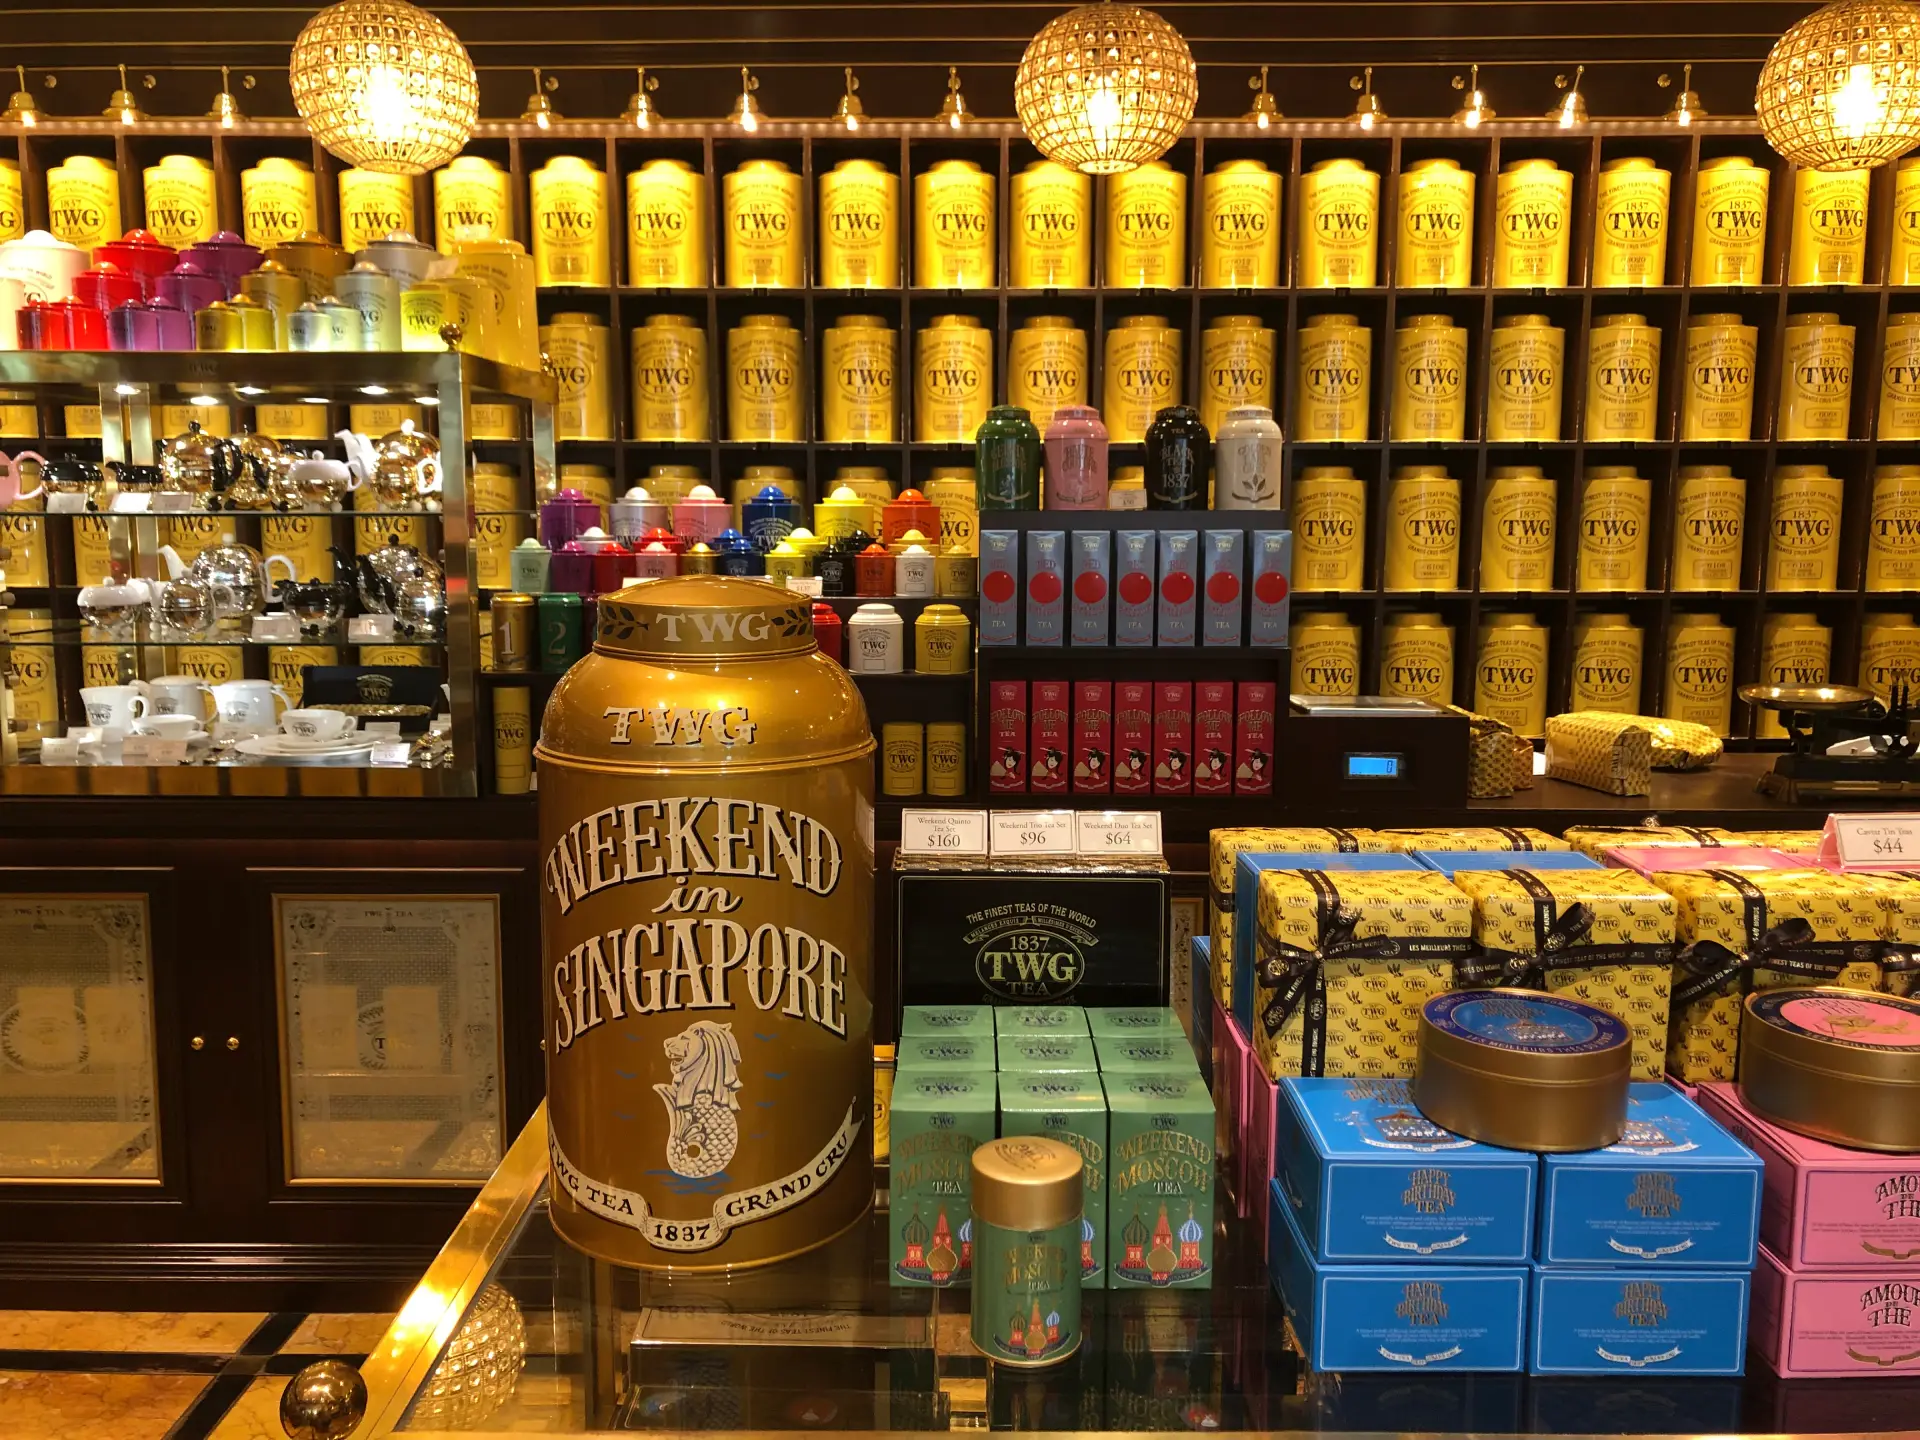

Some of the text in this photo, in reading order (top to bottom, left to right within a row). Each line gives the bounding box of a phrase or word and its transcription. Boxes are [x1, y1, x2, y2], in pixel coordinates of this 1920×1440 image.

[60, 199, 82, 210] 1837
[1134, 203, 1157, 213] 1837
[1522, 202, 1547, 213] 1837
[1729, 200, 1752, 210] 1837
[52, 211, 99, 227] TWG
[150, 210, 197, 227] TWG
[350, 211, 401, 229] TWG
[542, 212, 592, 229] TWG
[737, 213, 786, 231] TWG
[937, 213, 986, 231] TWG
[1120, 213, 1170, 231] TWG
[1319, 213, 1368, 231] TWG
[1506, 213, 1559, 230] TWG
[1608, 211, 1660, 230] TWG
[1711, 211, 1761, 229] TWG
[62, 227, 84, 236] TEA
[1133, 231, 1157, 240] TEA
[1520, 230, 1546, 239] TEA
[1726, 229, 1750, 237] TEA
[1325, 359, 1346, 368] 1837
[1716, 357, 1739, 366] 1837
[640, 367, 689, 385] TWG
[928, 370, 977, 387] TWG
[1121, 369, 1171, 388] TWG
[1309, 368, 1359, 386] TWG
[1500, 368, 1552, 386] TWG
[1698, 367, 1749, 385] TWG
[1801, 367, 1849, 384] TWG
[1322, 385, 1347, 395] TEA
[1713, 384, 1737, 393] TEA
[1162, 473, 1190, 488] 1837
[1318, 510, 1341, 519] 1837
[1793, 510, 1817, 519] 1837
[1303, 519, 1353, 537] TWG
[1409, 519, 1456, 536] TWG
[1503, 519, 1551, 537] TWG
[1775, 519, 1830, 536] TWG
[1316, 536, 1341, 545] TEA
[1790, 536, 1815, 545] TEA
[655, 611, 771, 643] TWG
[1215, 621, 1230, 629] TEA
[499, 621, 515, 655] 1
[548, 621, 567, 655] 2
[861, 641, 886, 650] TWG
[928, 641, 952, 650] TWG
[1405, 658, 1428, 667] 1837
[1497, 658, 1521, 667] 1837
[180, 663, 230, 681] TWG
[1305, 667, 1353, 684] TWG
[1390, 666, 1440, 684] TWG
[1483, 666, 1534, 684] TWG
[1679, 666, 1728, 684] TWG
[363, 687, 387, 697] TWG
[1402, 684, 1428, 693] TEA
[1494, 684, 1520, 693] TEA
[990, 708, 1026, 723] FOLLOW
[1032, 708, 1068, 723] FOLLOW
[1075, 708, 1111, 723] FOLLOW
[1196, 709, 1232, 724] FOLLOW
[1237, 709, 1273, 725] FOLLOW
[496, 728, 524, 739] TWG
[603, 706, 757, 745] TWG
[889, 754, 916, 763] TWG
[932, 754, 958, 763] TWG
[917, 817, 971, 825] Weekend Quinto
[1029, 821, 1043, 829] Trio
[1044, 821, 1055, 829] Tea
[1056, 821, 1066, 829] Set
[1142, 821, 1153, 829] Set
[1019, 831, 1046, 846] $96
[1105, 831, 1131, 845] $64
[1882, 827, 1896, 836] Tin
[928, 834, 961, 848] $160
[1873, 837, 1903, 854] $44
[546, 796, 843, 915] WEEKEND
[651, 876, 743, 914] in
[966, 911, 984, 925] THE
[984, 904, 1013, 919] FINEST
[1014, 903, 1036, 913] TEAS
[1037, 903, 1049, 913] OF
[1050, 905, 1068, 917] THE
[1068, 909, 1097, 929] WORLD
[1636, 919, 1658, 928] TWG
[1284, 924, 1310, 934] TWG
[1362, 923, 1389, 934] TWG
[1010, 935, 1050, 951] 1837
[983, 951, 1077, 982] TWG
[554, 918, 847, 1055] SINGAPORE
[1006, 981, 1051, 996] TEA
[931, 1116, 955, 1125] TWG
[1044, 1117, 1066, 1126] TWG
[1154, 1117, 1176, 1126] TWG
[1114, 1129, 1212, 1165] WEEKEND
[550, 1134, 634, 1216] TWG TEA
[725, 1173, 812, 1218] GRAND
[815, 1132, 848, 1184] CRU
[1112, 1156, 1213, 1196] MOSCOW
[1408, 1168, 1452, 1187] HAPPY
[1633, 1171, 1677, 1191] HAPPY
[932, 1180, 963, 1194] TEA
[1153, 1181, 1184, 1195] TEA
[1875, 1174, 1920, 1204] AMO
[1401, 1184, 1456, 1207] BIRTHDAY
[1625, 1188, 1682, 1211] BIRTHDAY
[1415, 1200, 1446, 1213] TEA
[1641, 1204, 1671, 1218] TEA
[653, 1223, 710, 1242] 1837
[1402, 1281, 1444, 1300] HAPPY
[1621, 1281, 1663, 1300] HAPPY
[1395, 1298, 1449, 1319] BIRTHDAY
[1614, 1298, 1668, 1320] BIRTHDAY
[1409, 1313, 1440, 1326] TEA
[1629, 1313, 1658, 1326] TEA
